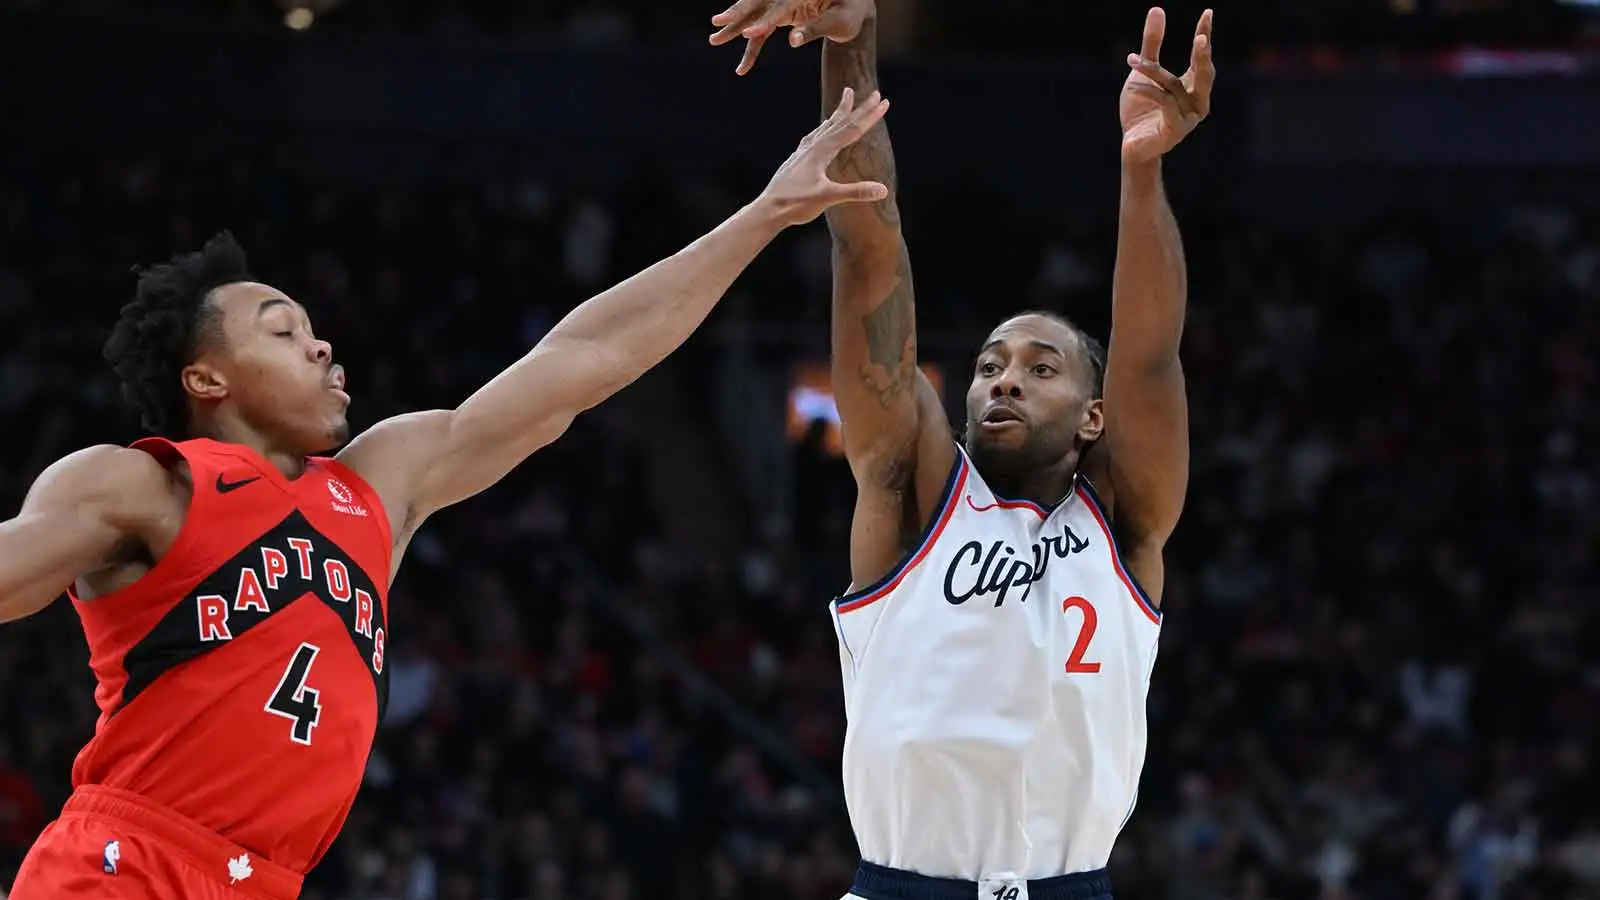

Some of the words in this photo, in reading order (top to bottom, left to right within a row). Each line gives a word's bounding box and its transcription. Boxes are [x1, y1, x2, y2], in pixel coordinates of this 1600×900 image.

[197, 537, 385, 673] RAPTORS
[1062, 596, 1102, 673] 2
[264, 642, 320, 745] 4
